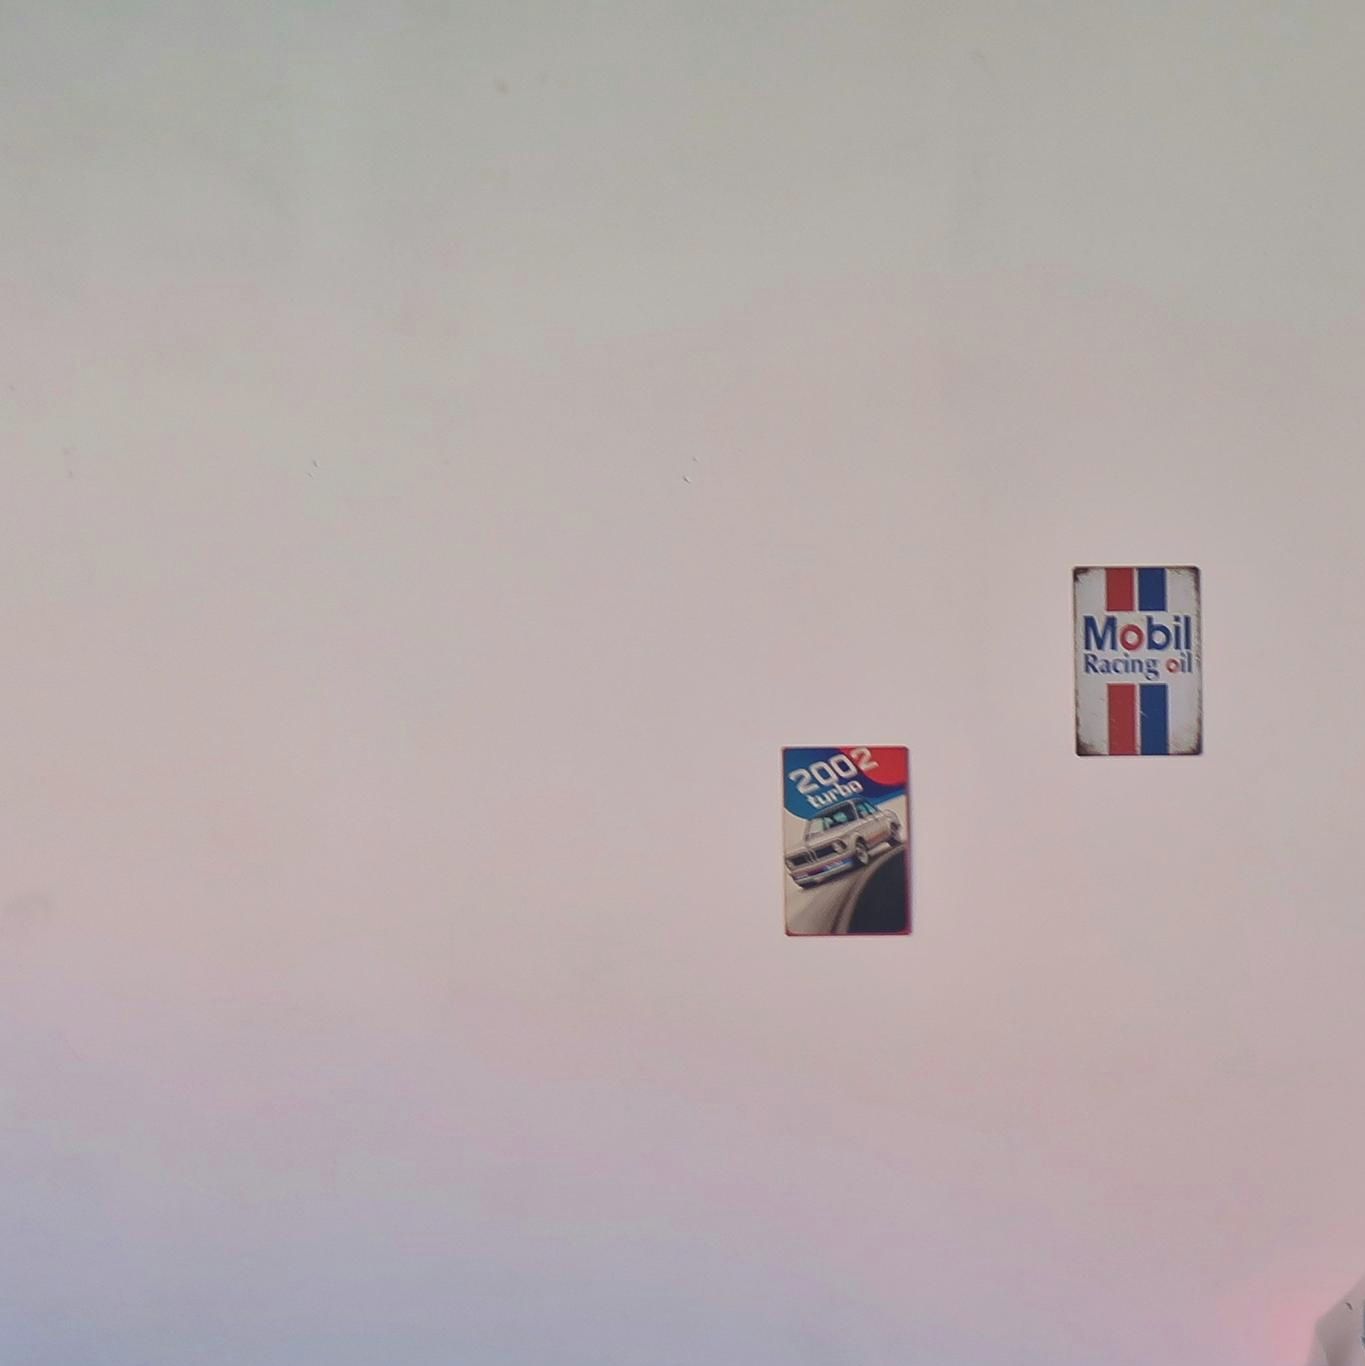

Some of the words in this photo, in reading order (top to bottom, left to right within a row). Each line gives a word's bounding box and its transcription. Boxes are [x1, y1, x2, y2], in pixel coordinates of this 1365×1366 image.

[1083, 615, 1192, 650] Mobil
[1084, 652, 1160, 681] Racing
[1166, 651, 1193, 674] oil
[789, 746, 880, 795] 2002
[806, 780, 864, 808] turbo
